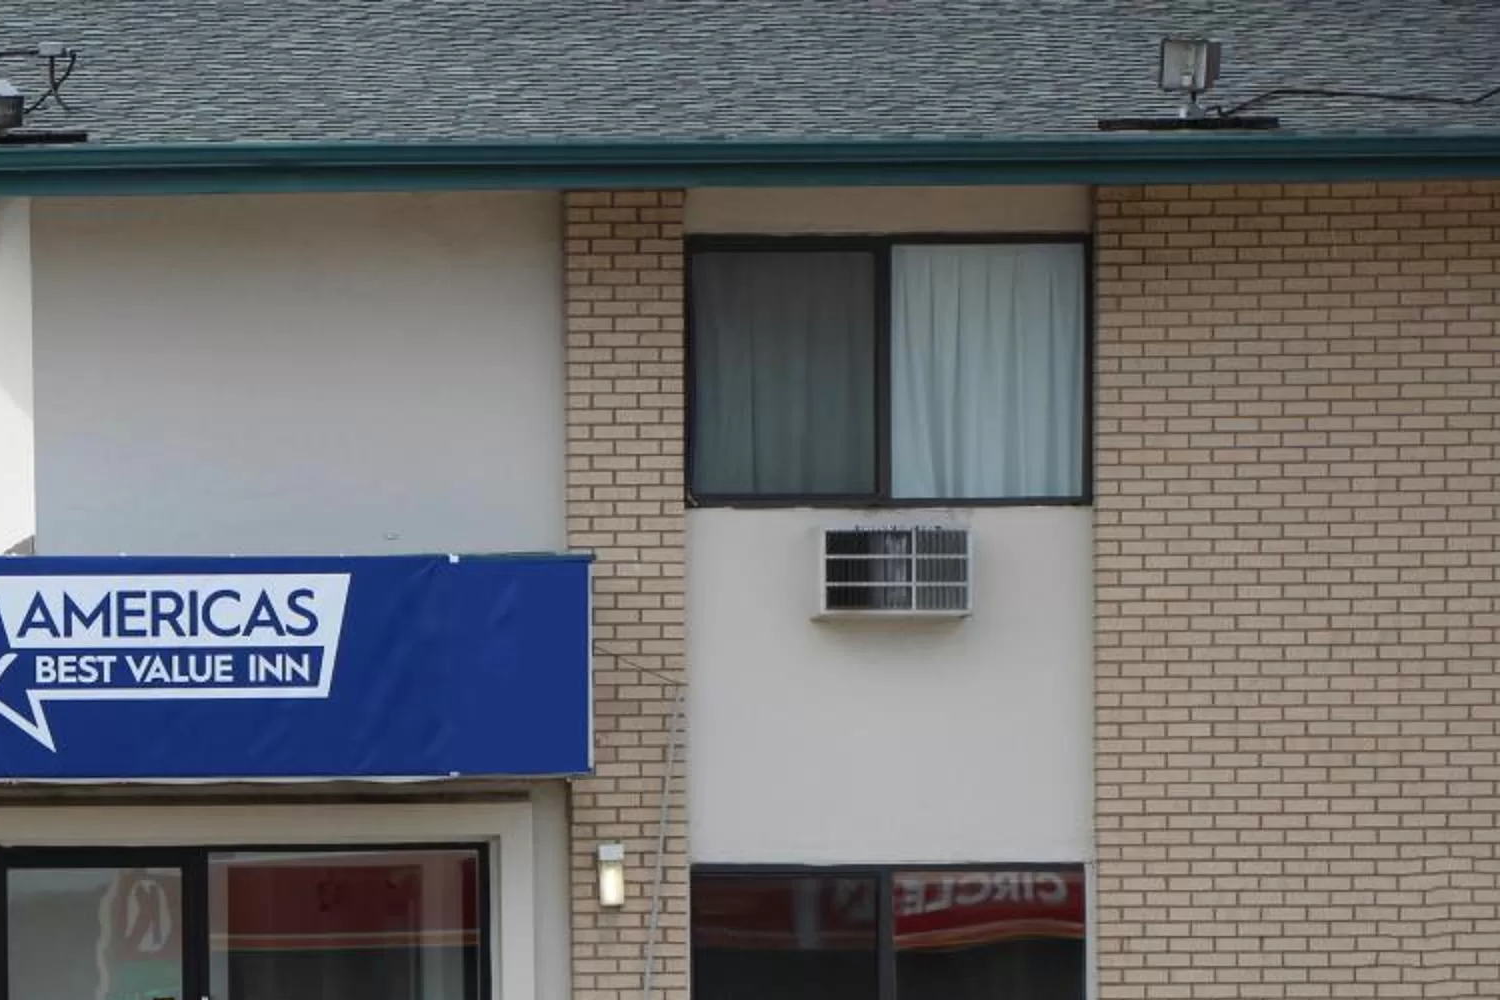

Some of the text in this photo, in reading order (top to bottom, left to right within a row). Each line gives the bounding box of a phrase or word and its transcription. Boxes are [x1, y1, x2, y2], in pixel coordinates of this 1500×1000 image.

[17, 589, 318, 638] AMERICAS
[35, 654, 311, 684] BEST VALUE INN
